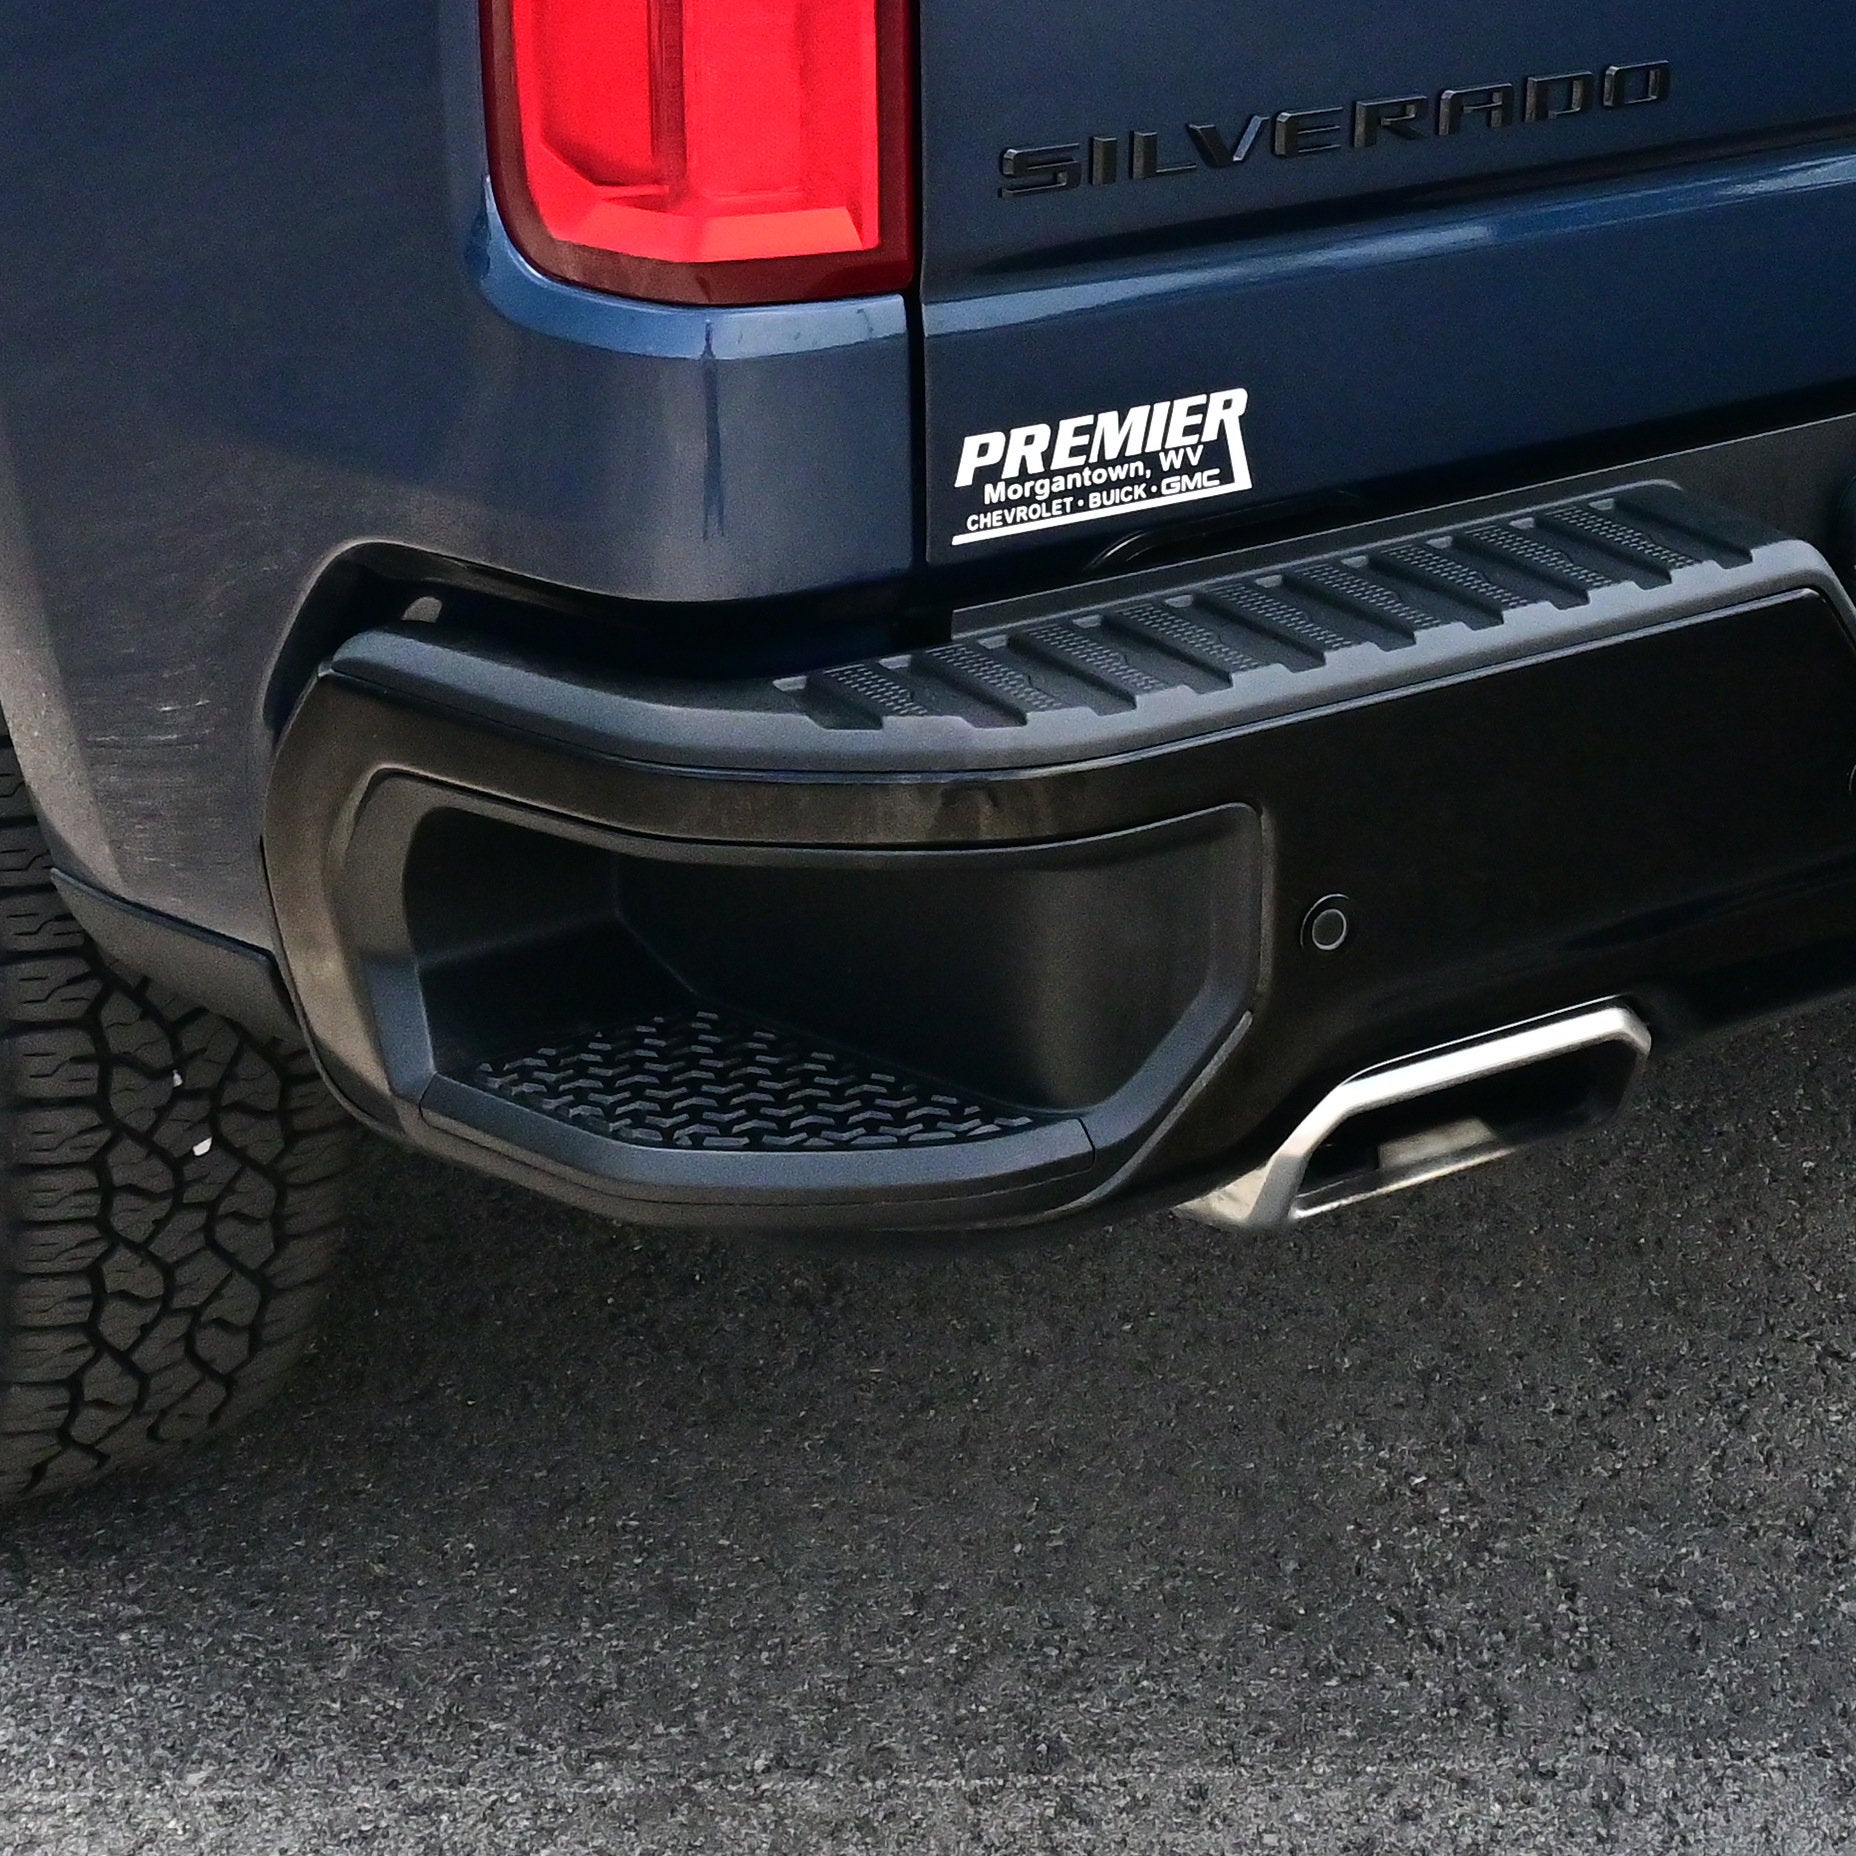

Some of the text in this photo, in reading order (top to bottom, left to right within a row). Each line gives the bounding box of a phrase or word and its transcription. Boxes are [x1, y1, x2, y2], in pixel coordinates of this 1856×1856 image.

[997, 59, 1671, 198] SILVERADO
[954, 388, 1249, 488] PREMIER
[984, 444, 1204, 504] Morgantown, WV
[966, 468, 1221, 531] CHEVROLET BUICK GMC
